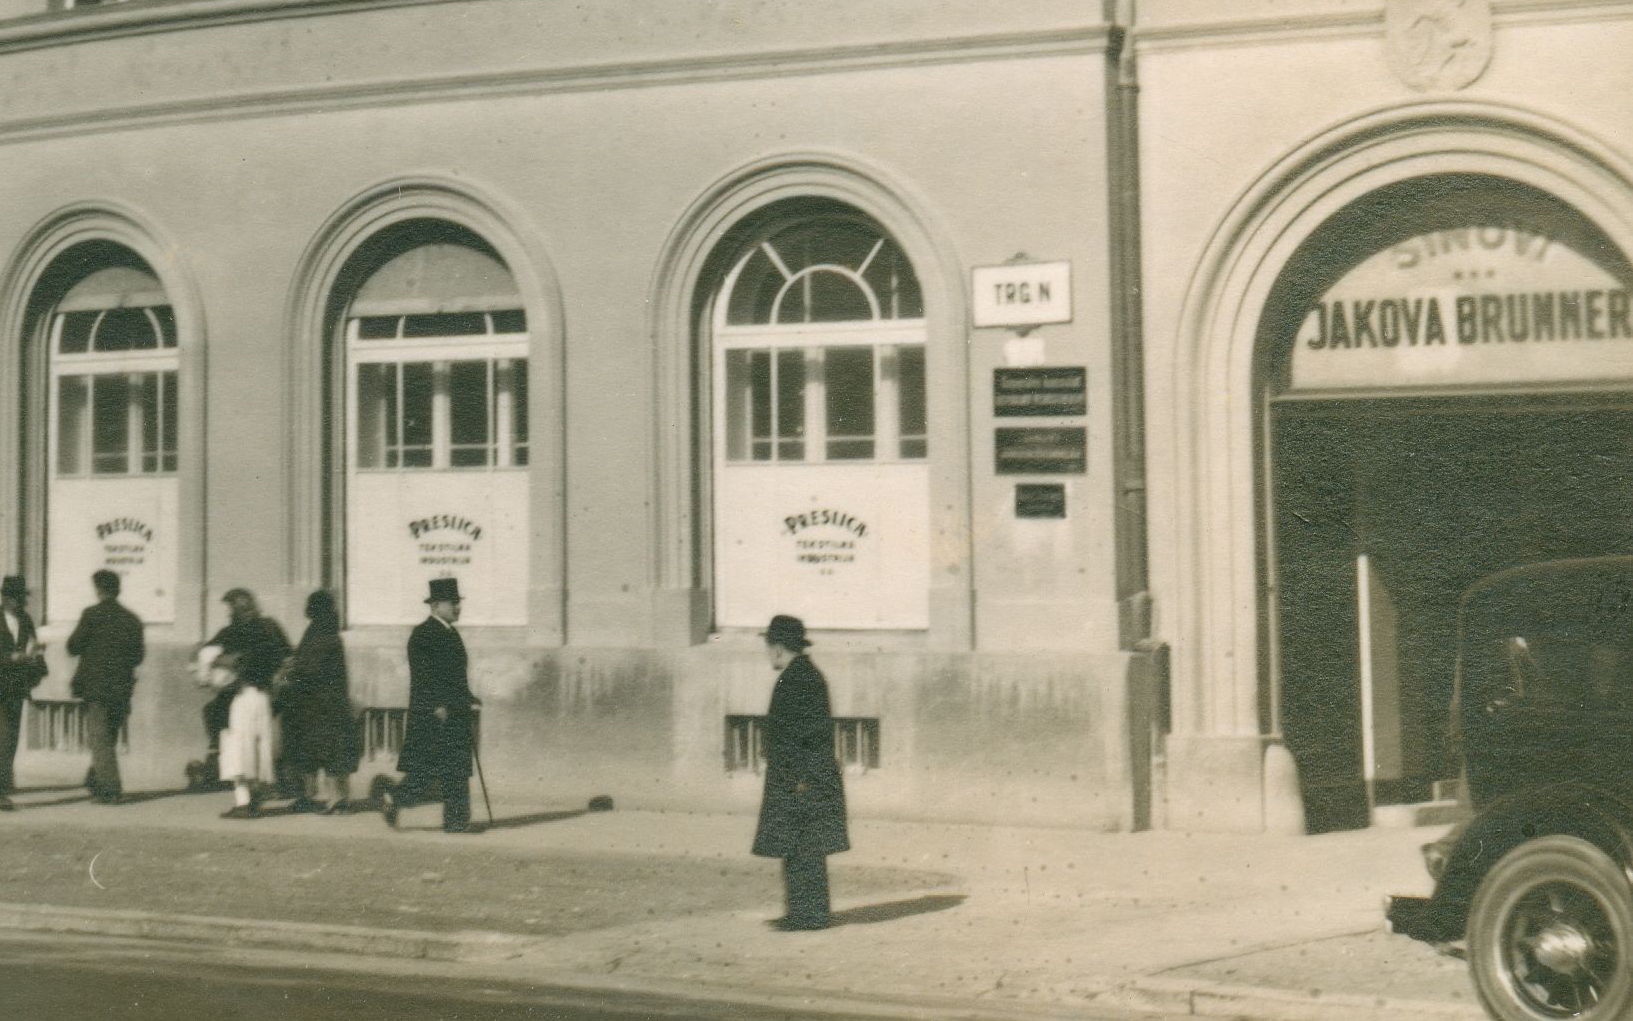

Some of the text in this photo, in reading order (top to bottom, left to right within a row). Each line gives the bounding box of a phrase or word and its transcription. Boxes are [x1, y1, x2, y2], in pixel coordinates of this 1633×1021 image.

[1395, 226, 1549, 269] SINOVI
[993, 281, 1032, 306] TRG
[1306, 288, 1633, 350] JAKOVA BRUNNER
[409, 515, 482, 540] PRESLICA
[784, 510, 866, 537] PRESLICA
